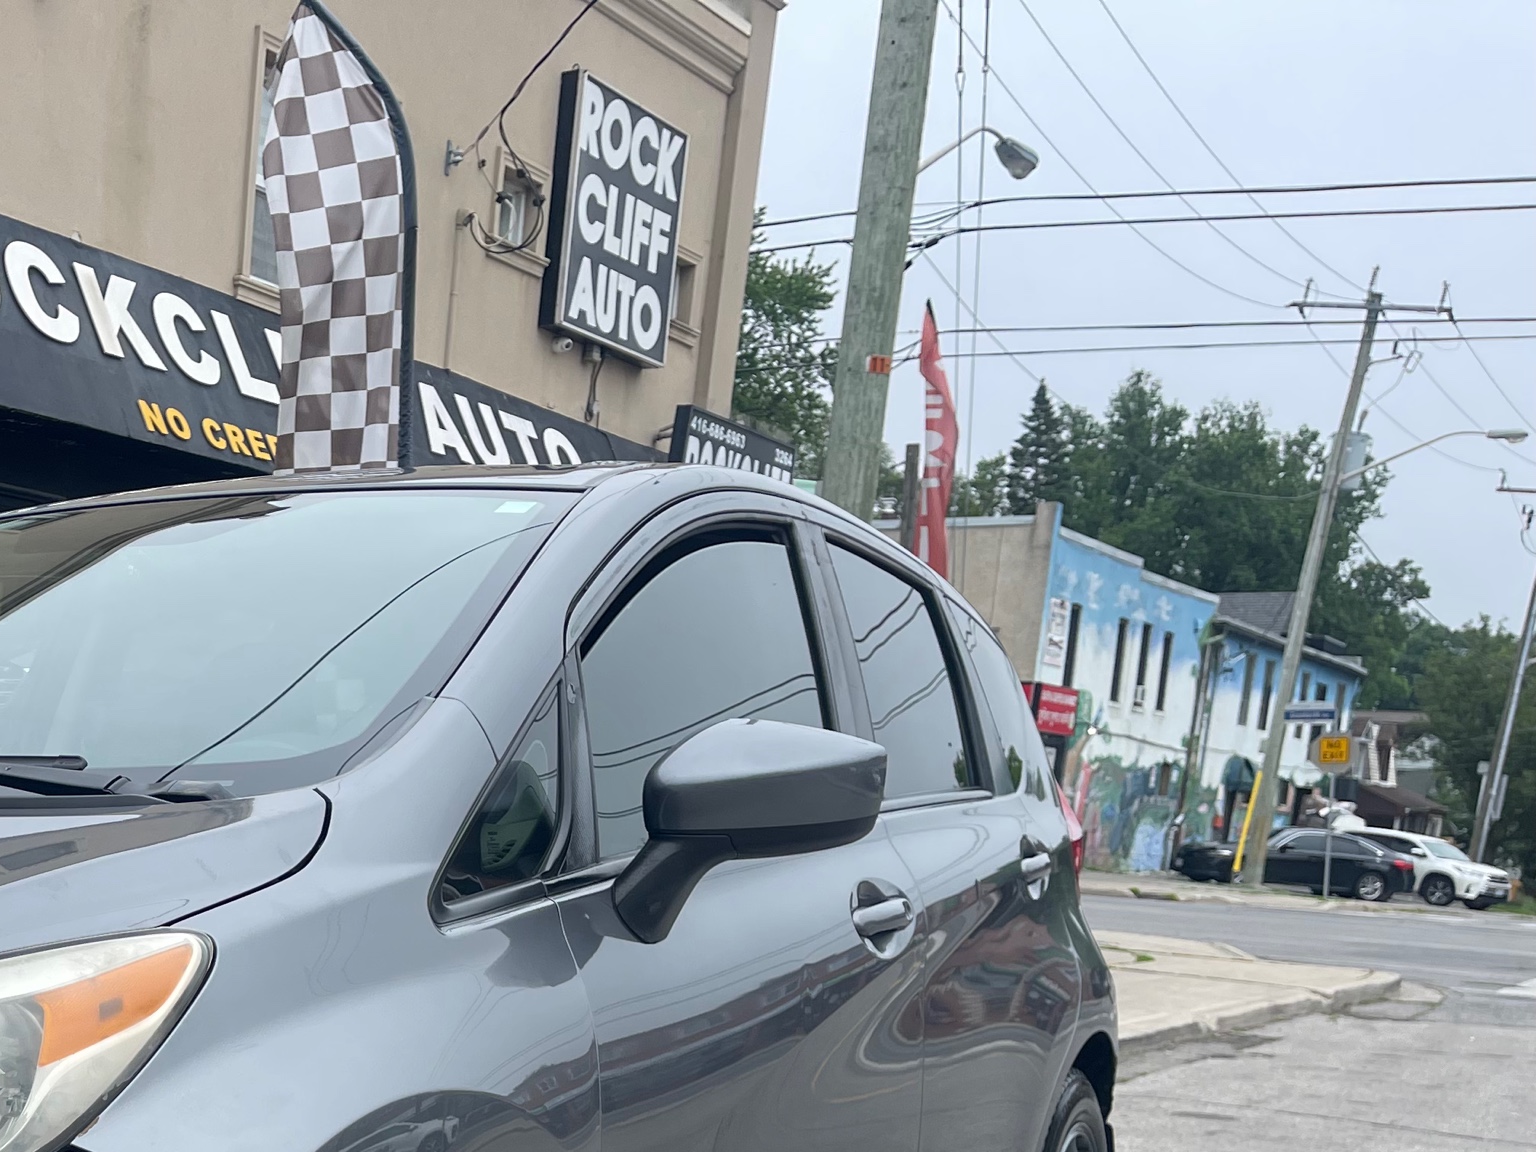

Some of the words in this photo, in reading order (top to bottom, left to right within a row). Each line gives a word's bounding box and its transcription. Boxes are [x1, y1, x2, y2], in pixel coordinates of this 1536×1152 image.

[580, 79, 685, 202] ROCK
[578, 173, 672, 274] CLIFF
[568, 257, 662, 351] AUTO
[137, 398, 192, 441] NO
